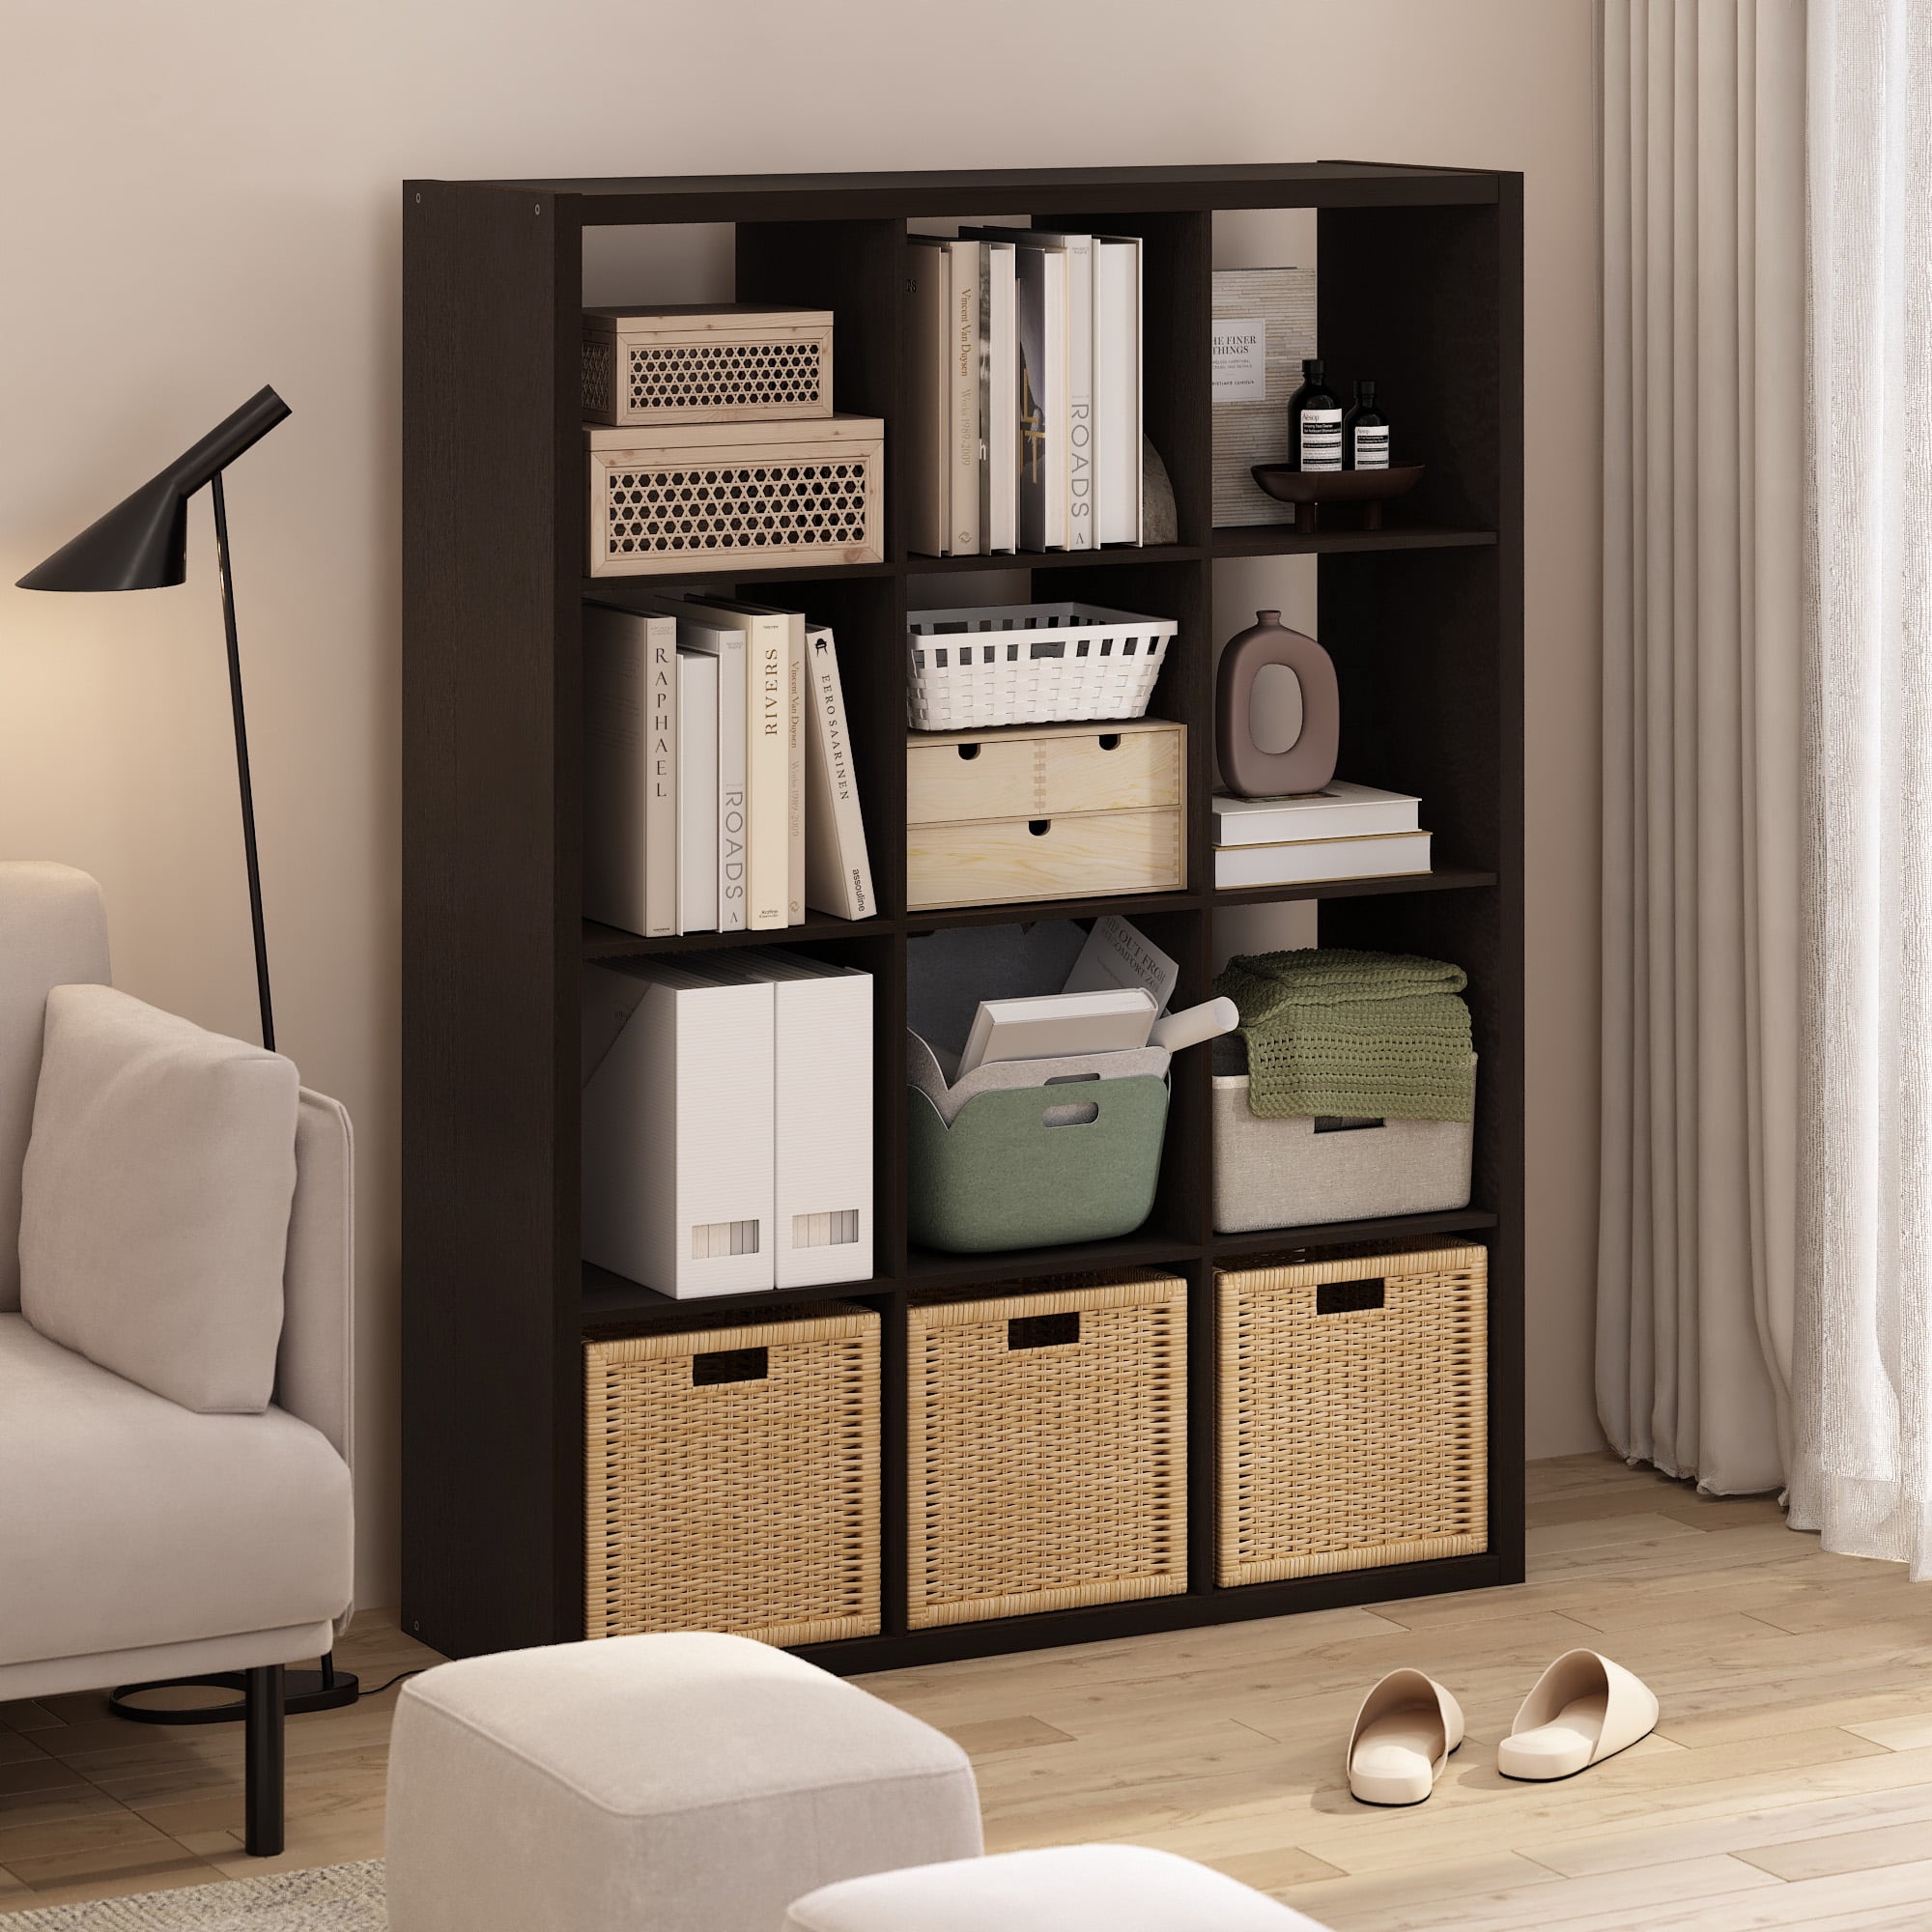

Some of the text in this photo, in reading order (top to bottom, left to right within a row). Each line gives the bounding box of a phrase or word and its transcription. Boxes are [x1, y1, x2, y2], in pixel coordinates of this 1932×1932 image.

[960, 288, 972, 323] Vincent
[960, 324, 972, 342] Van
[1212, 335, 1257, 346] HE FINER
[1212, 345, 1249, 355] THINGS
[959, 344, 972, 377] Duysen
[1070, 403, 1090, 518] ROADS
[765, 647, 779, 736] RIVERS
[790, 661, 800, 695] Vincent
[790, 696, 800, 714] Van
[655, 647, 669, 798] RAPHAEL
[789, 716, 800, 749] Duysen
[821, 674, 850, 800] EERO SAARINEN
[725, 791, 744, 900] ROADS
[852, 868, 866, 912] assouline
[1119, 928, 1144, 957] OUT
